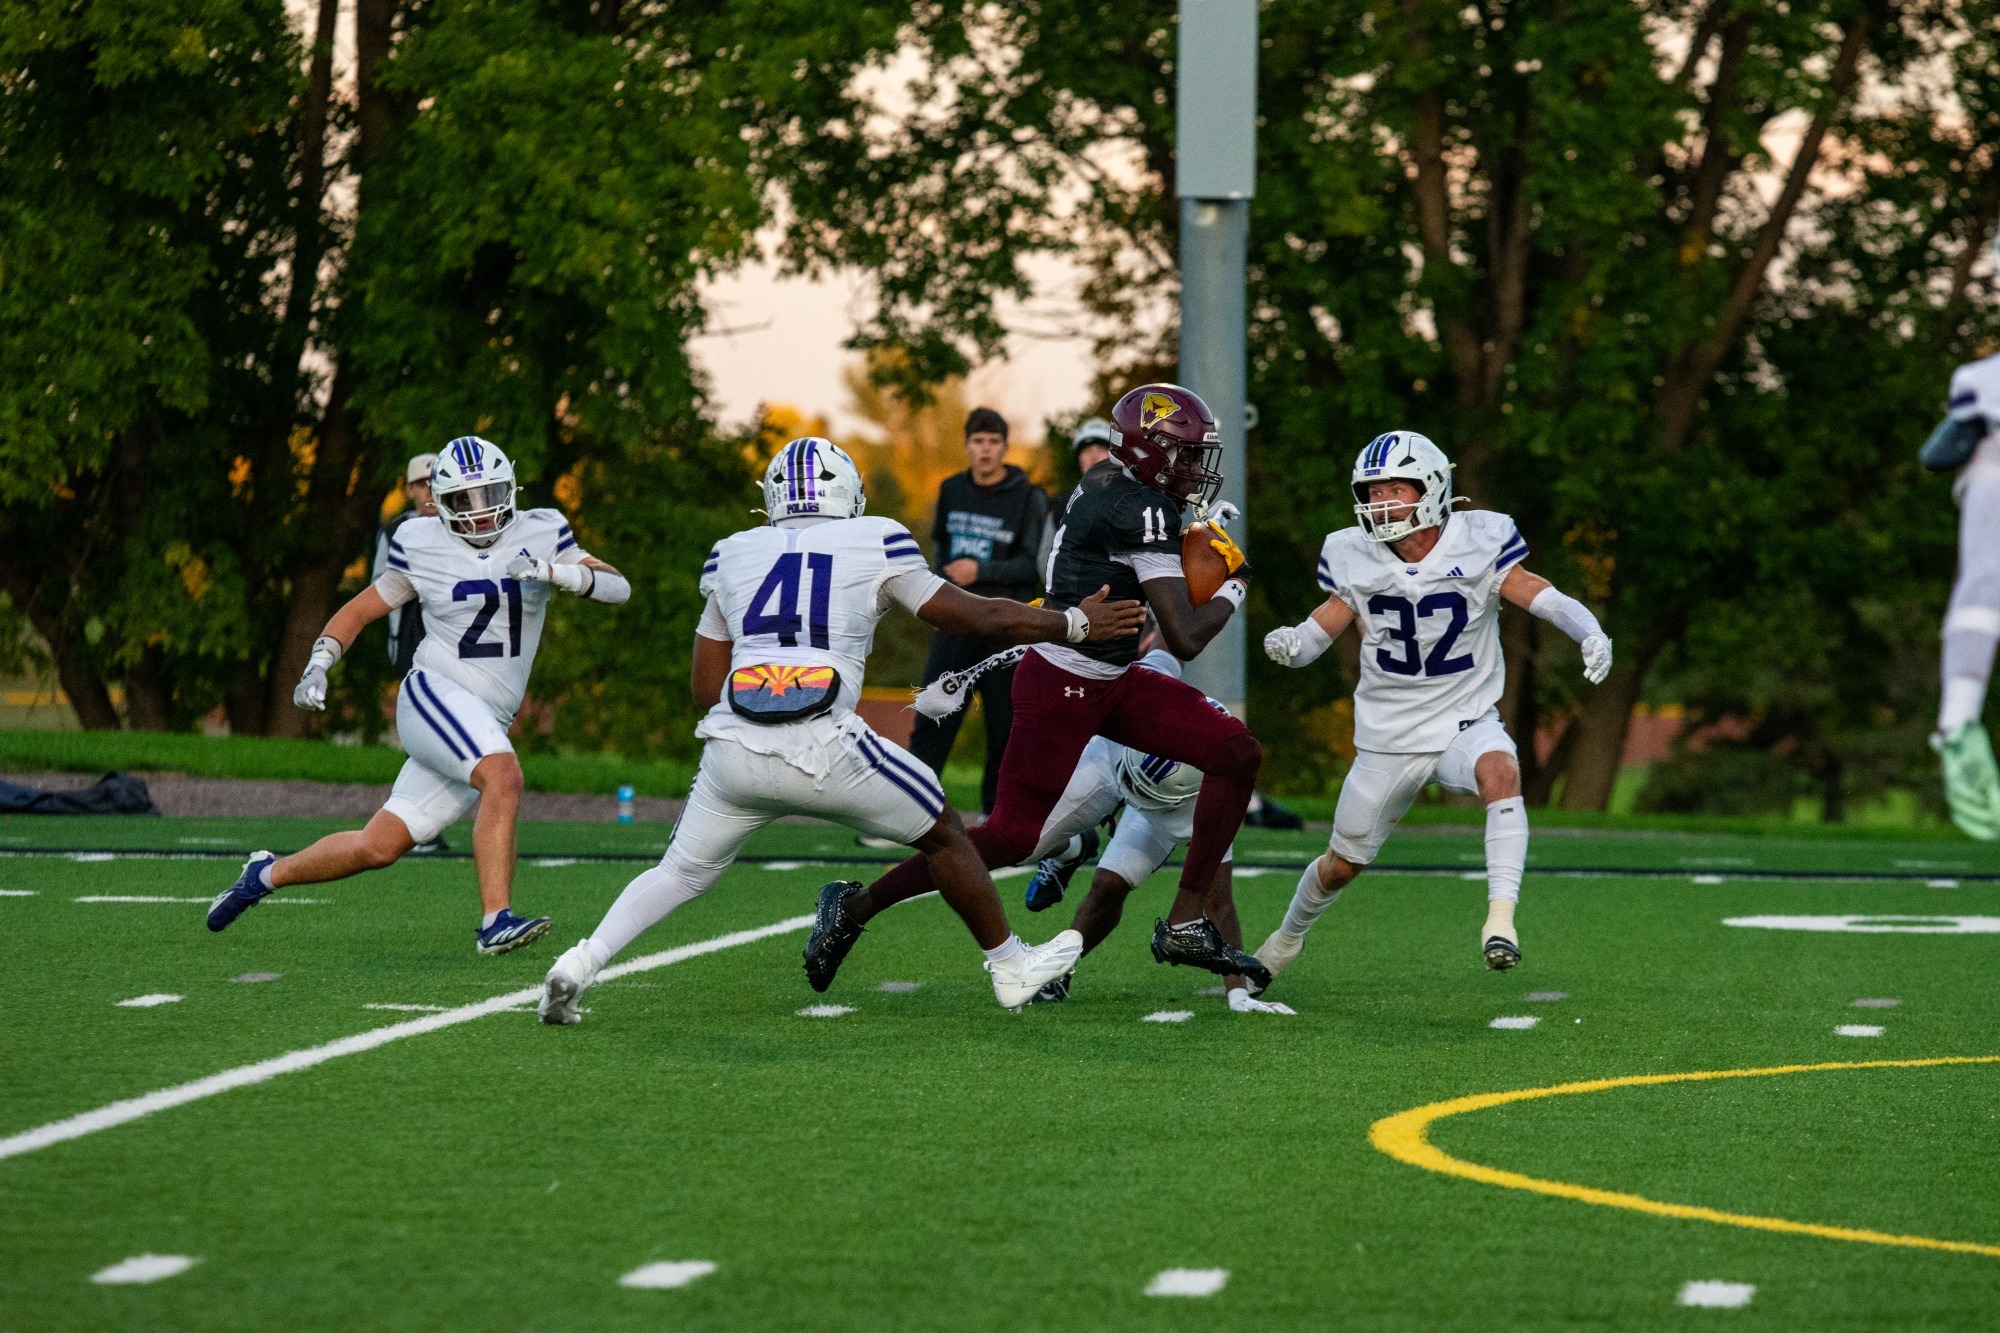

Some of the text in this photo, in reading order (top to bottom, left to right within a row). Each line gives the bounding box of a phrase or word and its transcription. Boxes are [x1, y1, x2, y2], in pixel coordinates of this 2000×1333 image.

[786, 502, 820, 515] POLARS
[1142, 506, 1168, 544] 11
[452, 578, 522, 659] 21
[742, 552, 833, 651] 41
[1367, 591, 1475, 677] 32
